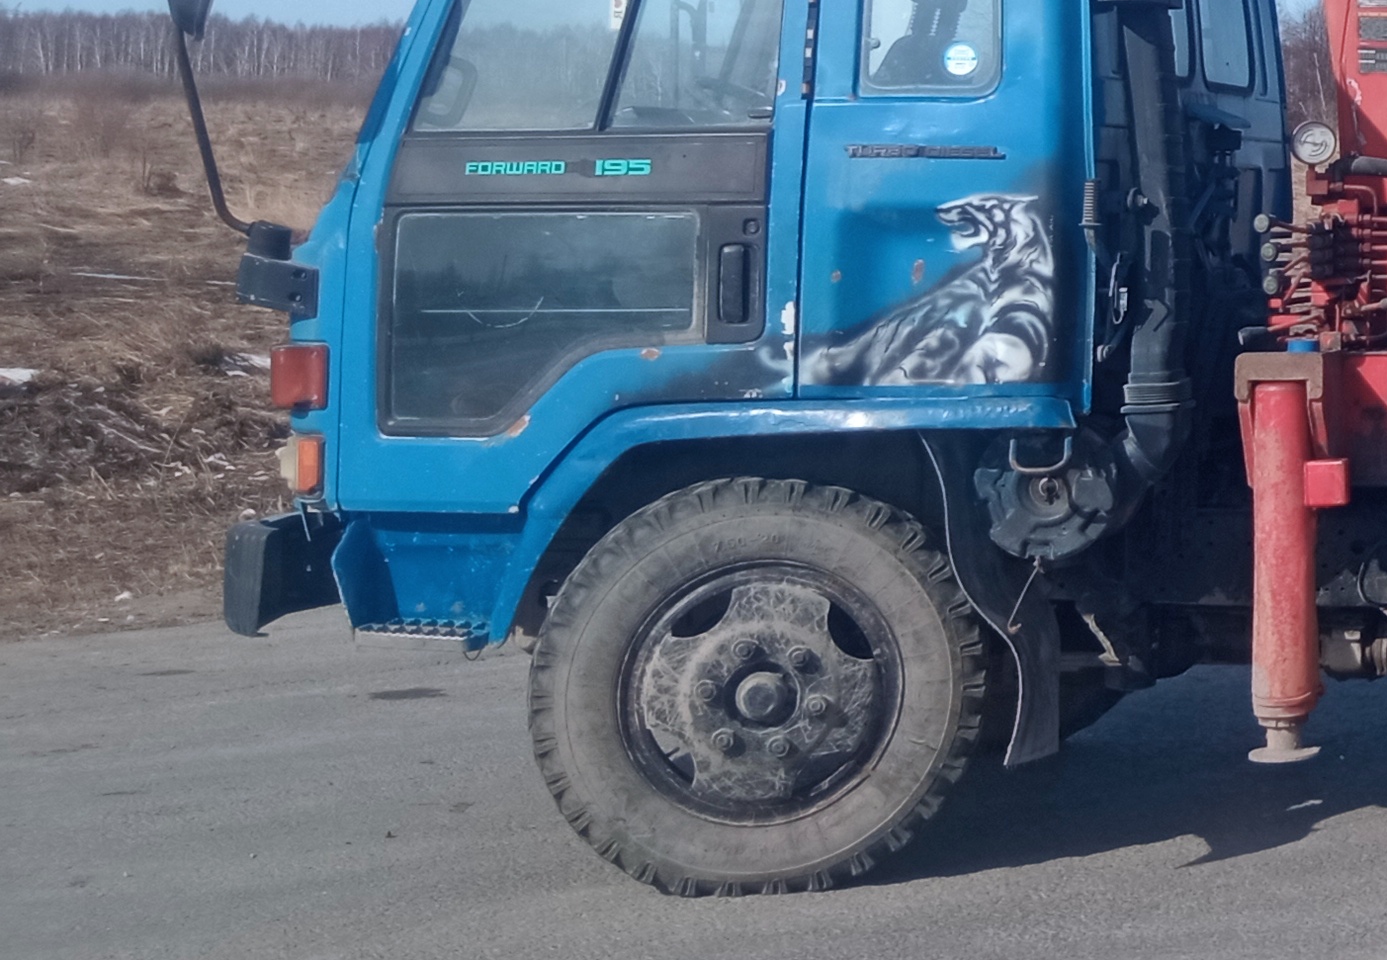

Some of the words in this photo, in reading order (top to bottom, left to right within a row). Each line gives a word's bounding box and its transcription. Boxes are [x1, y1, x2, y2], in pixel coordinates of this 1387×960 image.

[845, 144, 919, 159] TURBO
[924, 145, 1006, 160] DIESEL
[465, 161, 566, 176] FORWARD
[594, 159, 652, 176] 195
